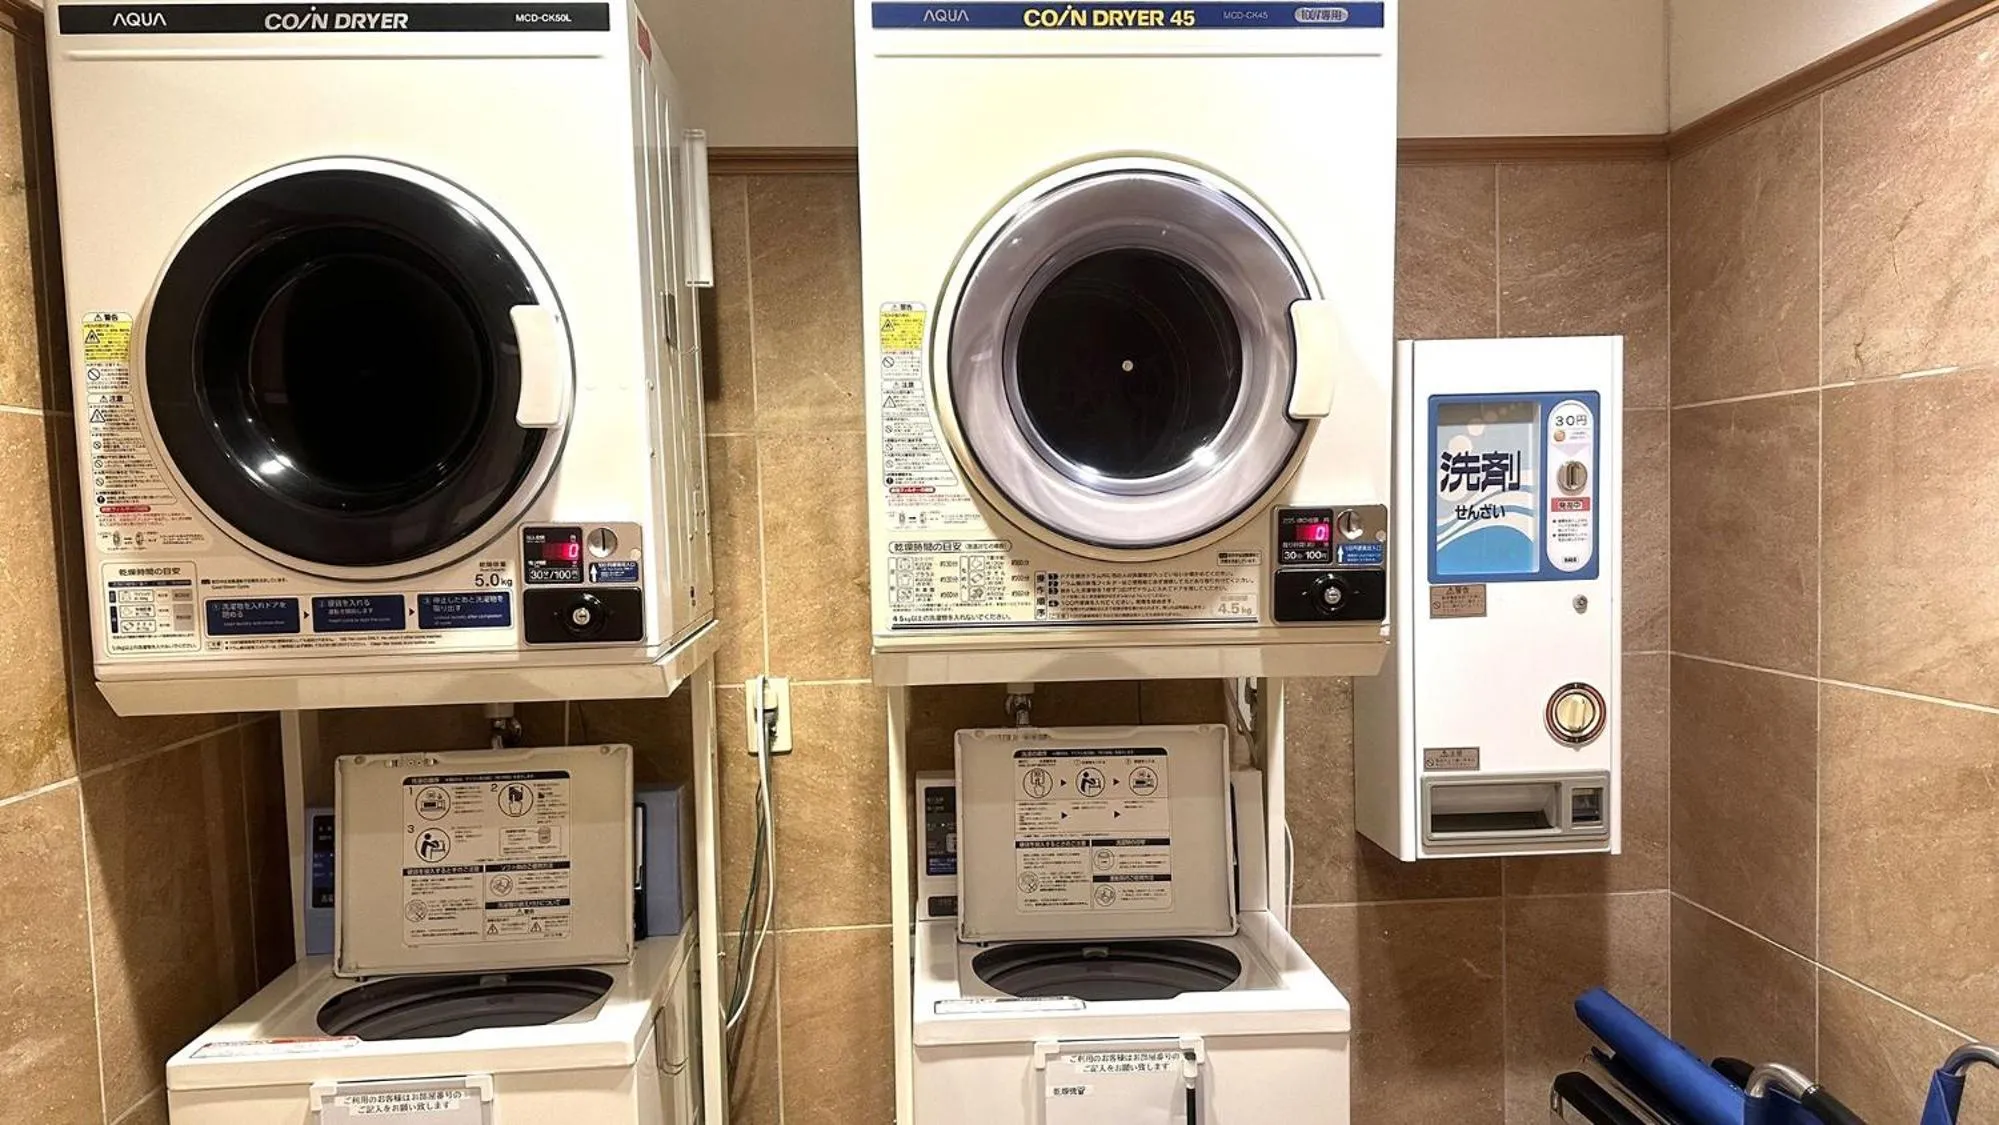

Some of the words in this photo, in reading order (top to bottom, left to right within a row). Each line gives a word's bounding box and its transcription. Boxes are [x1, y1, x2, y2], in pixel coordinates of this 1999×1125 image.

[113, 13, 167, 26] AQUA
[264, 6, 329, 30] COIN
[334, 13, 409, 29] DRYER
[923, 10, 969, 22] AQUA
[1023, 4, 1087, 27] COIN
[1092, 10, 1165, 26] DRYER
[1170, 10, 1196, 26] 45
[1555, 414, 1588, 427] 30円
[1440, 450, 1521, 493] 洗剤
[1455, 504, 1506, 520] せんざい
[569, 543, 579, 558] 0
[894, 542, 961, 552] 乾燥時間の目安
[119, 567, 181, 577] 乾燥時間の目安
[490, 784, 498, 792] 2
[407, 825, 415, 834] 3
[1070, 1052, 1180, 1063] ご利用のお客様はお部屋番号の
[1083, 1063, 1170, 1073] ご記入をお願い致します
[344, 1091, 462, 1105] ご利用のお客様はお部屋番号の
[358, 1101, 450, 1114] ご記入をお願い致します
